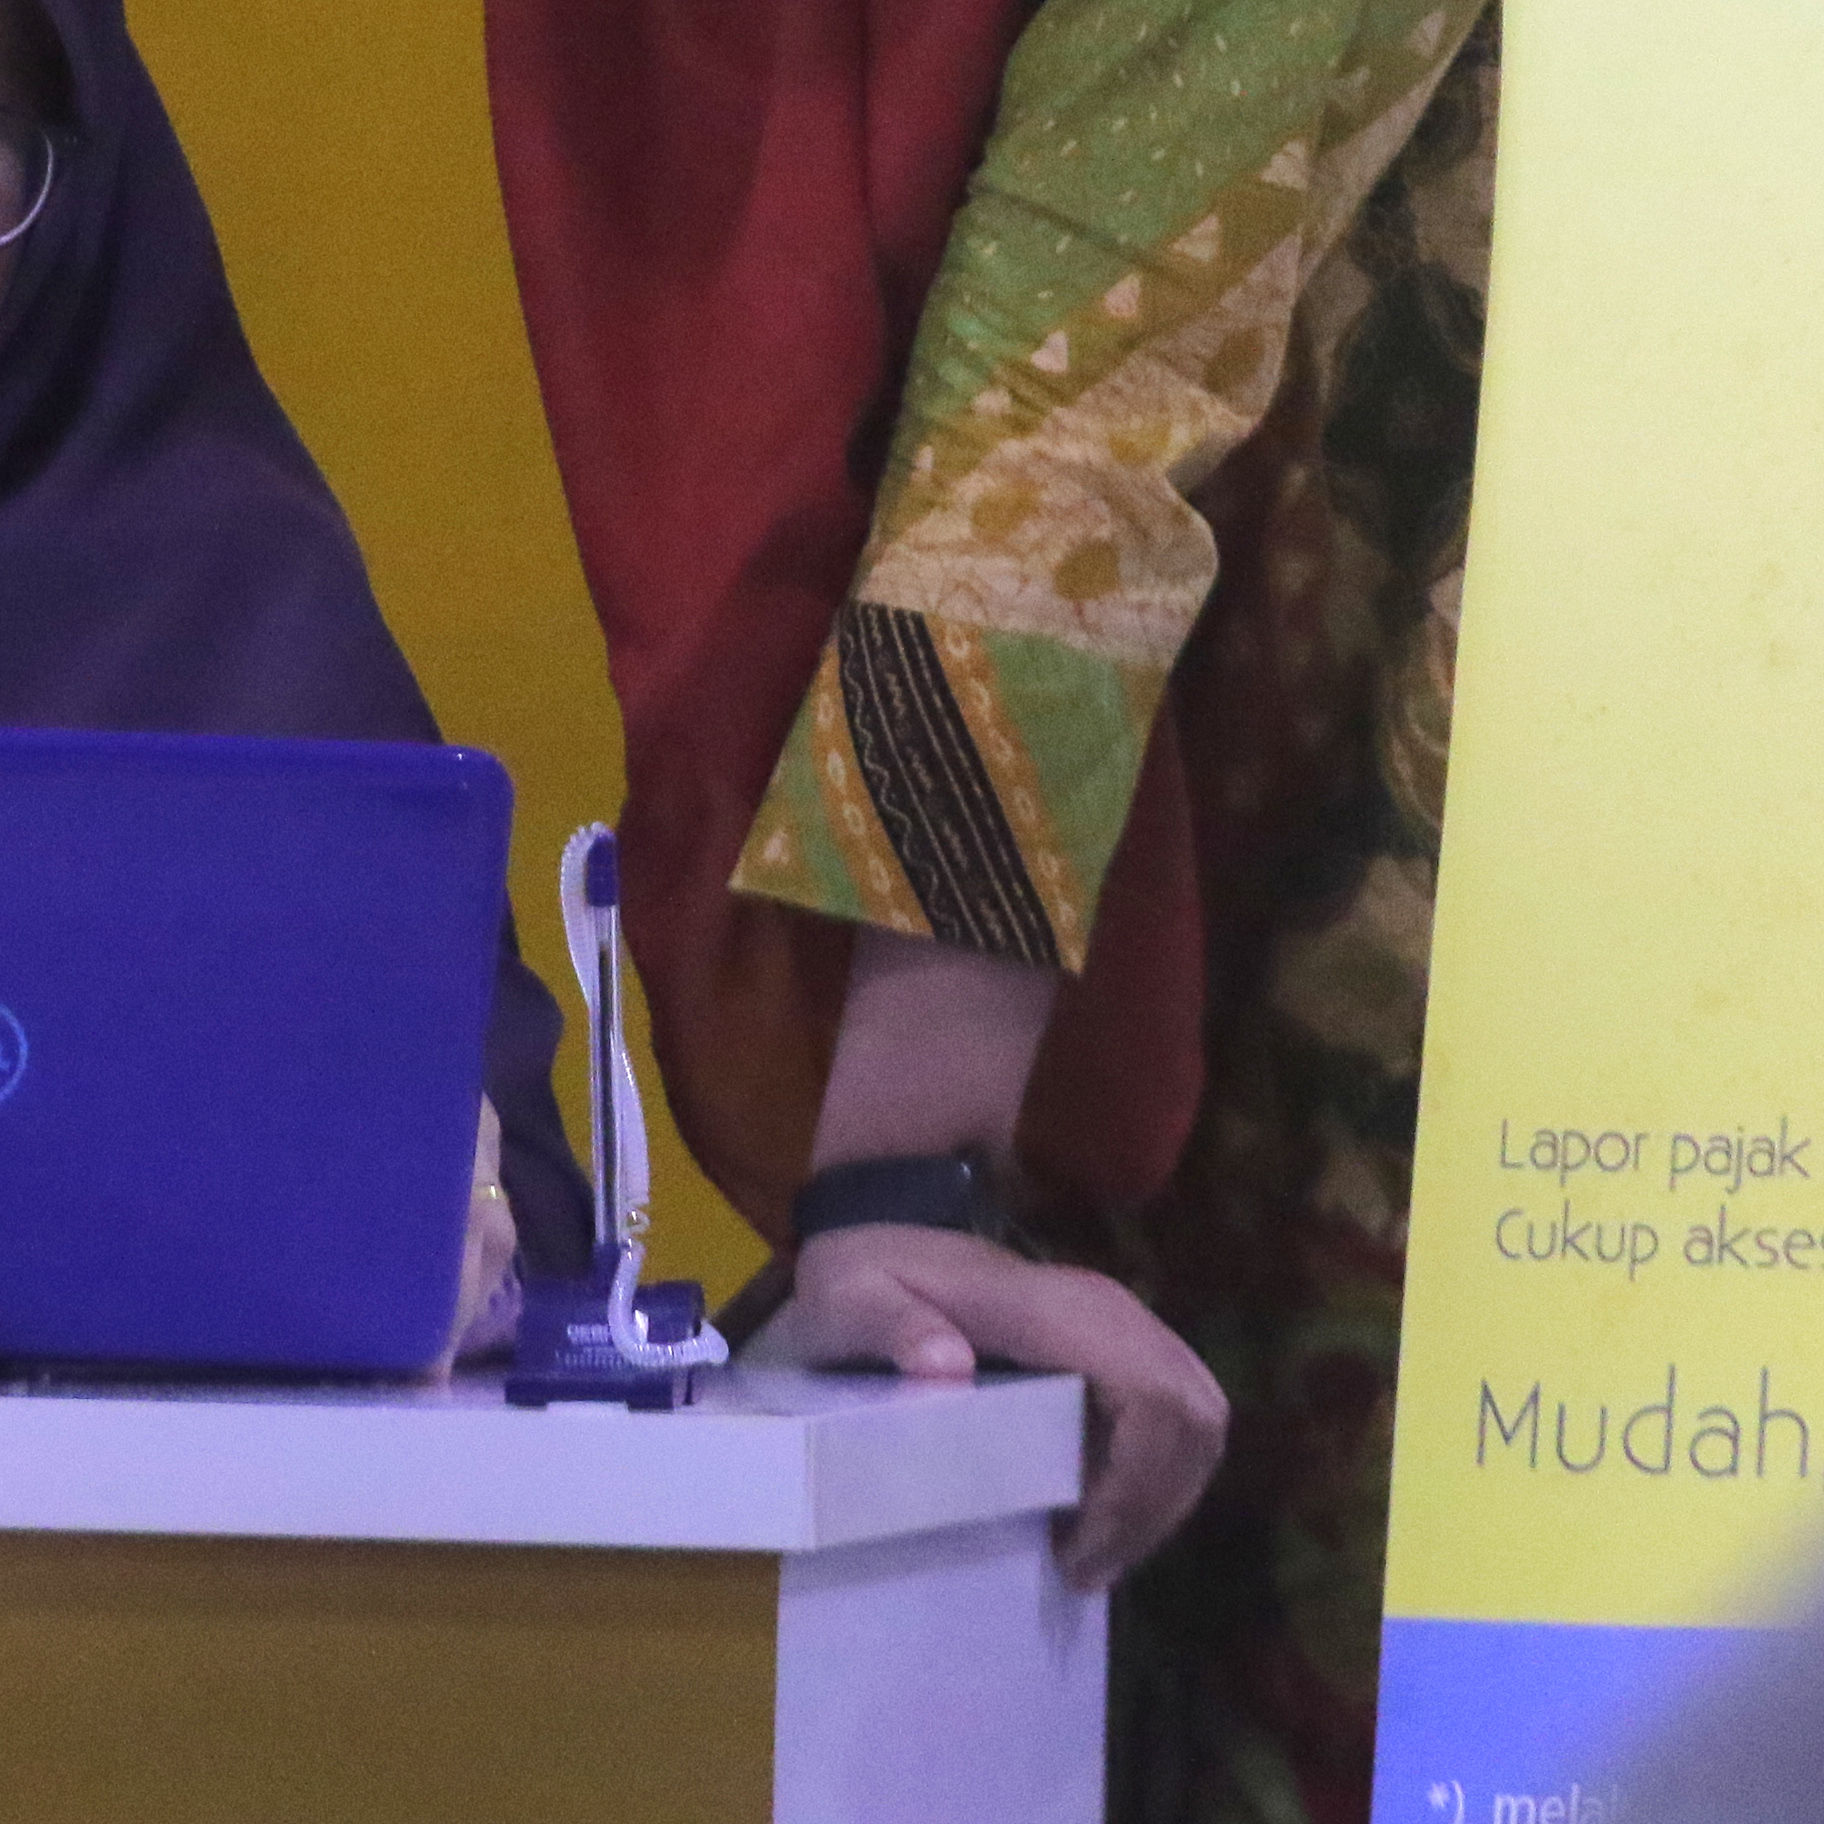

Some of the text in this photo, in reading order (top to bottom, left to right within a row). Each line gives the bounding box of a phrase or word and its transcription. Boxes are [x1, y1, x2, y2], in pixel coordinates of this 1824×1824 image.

[1498, 1118, 1651, 1189] Lapor
[1668, 1115, 1812, 1195] pajak
[1495, 1198, 1660, 1283] Cukup
